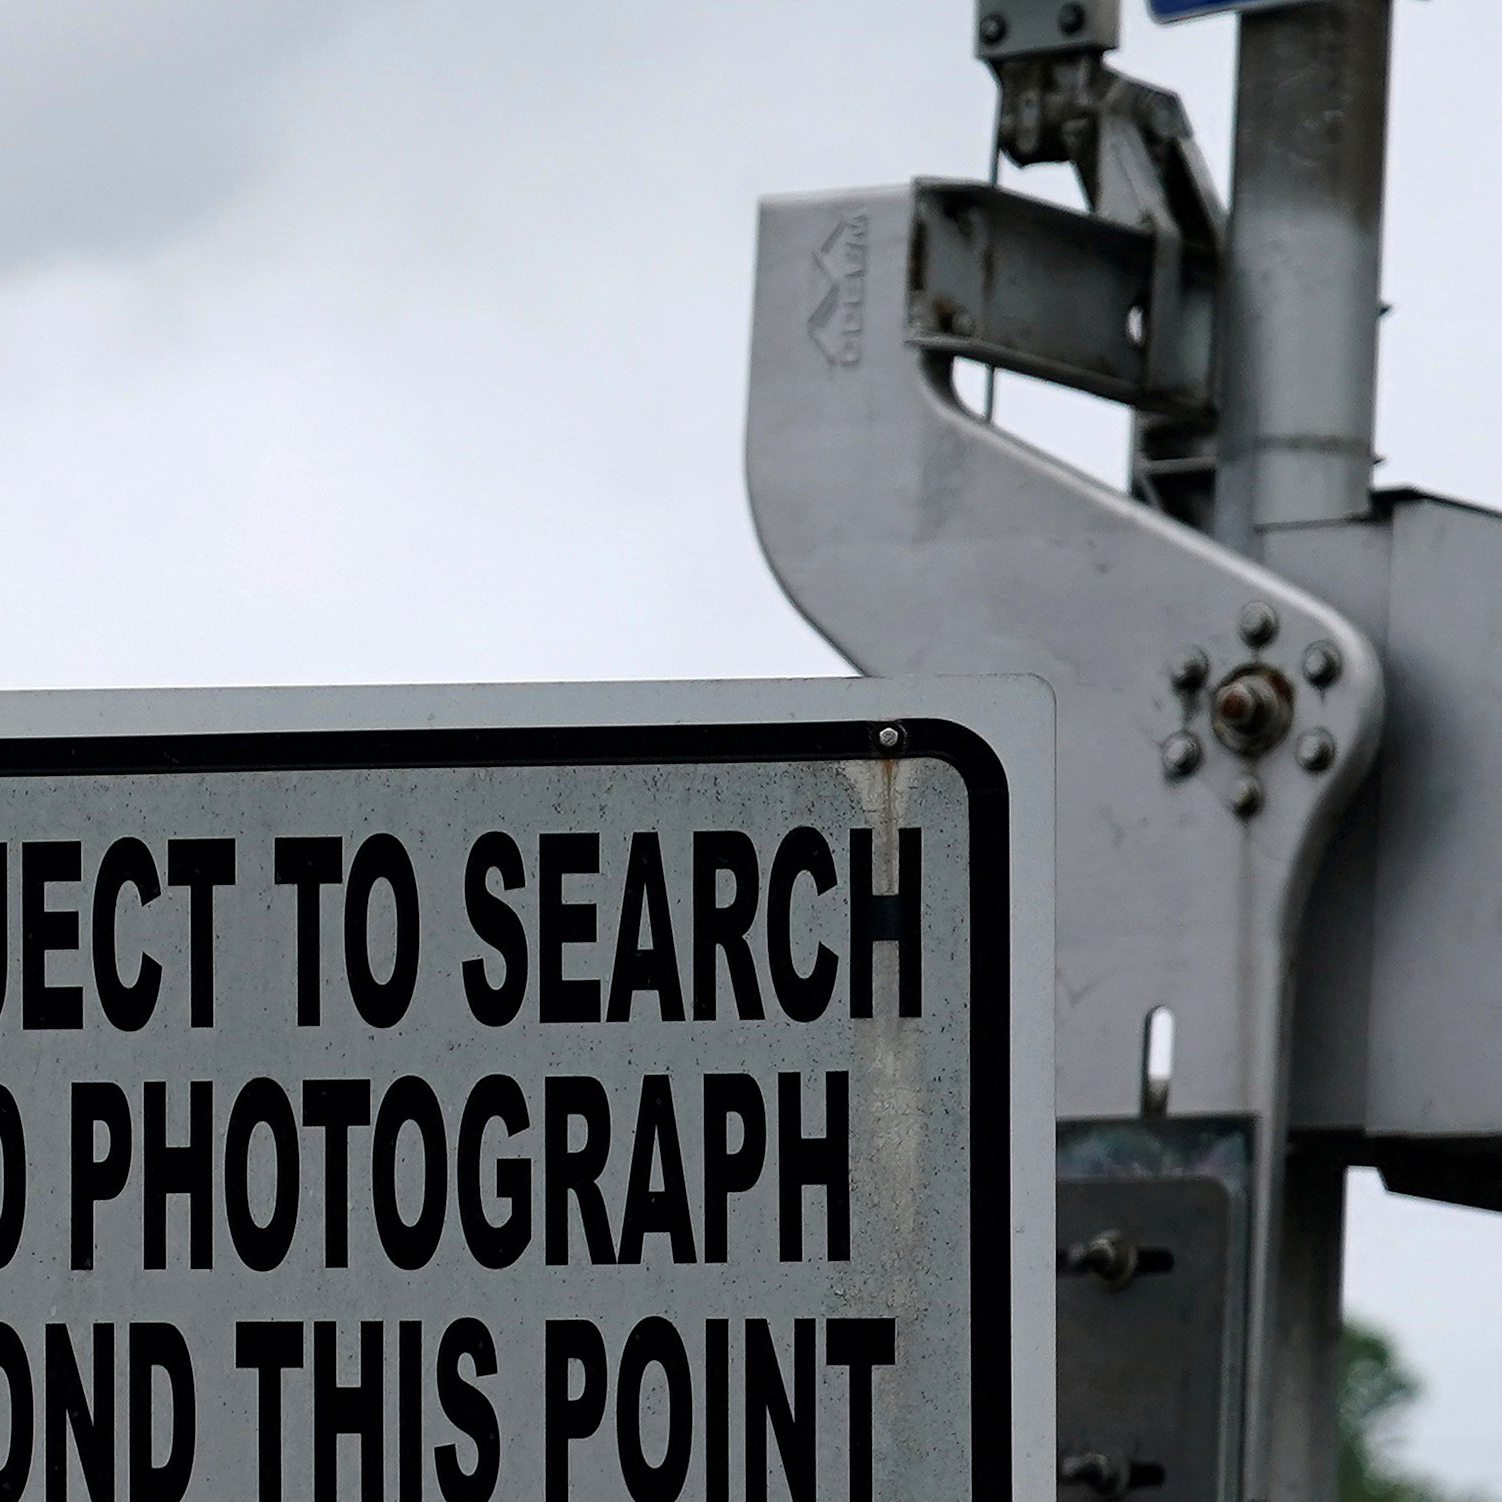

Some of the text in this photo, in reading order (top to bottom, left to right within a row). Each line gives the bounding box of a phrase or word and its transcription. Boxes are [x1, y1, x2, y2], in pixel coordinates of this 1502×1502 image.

[274, 833, 419, 1028] TO
[462, 825, 923, 1027] SEARCH
[71, 1071, 852, 1272] PHOTOGRAPH
